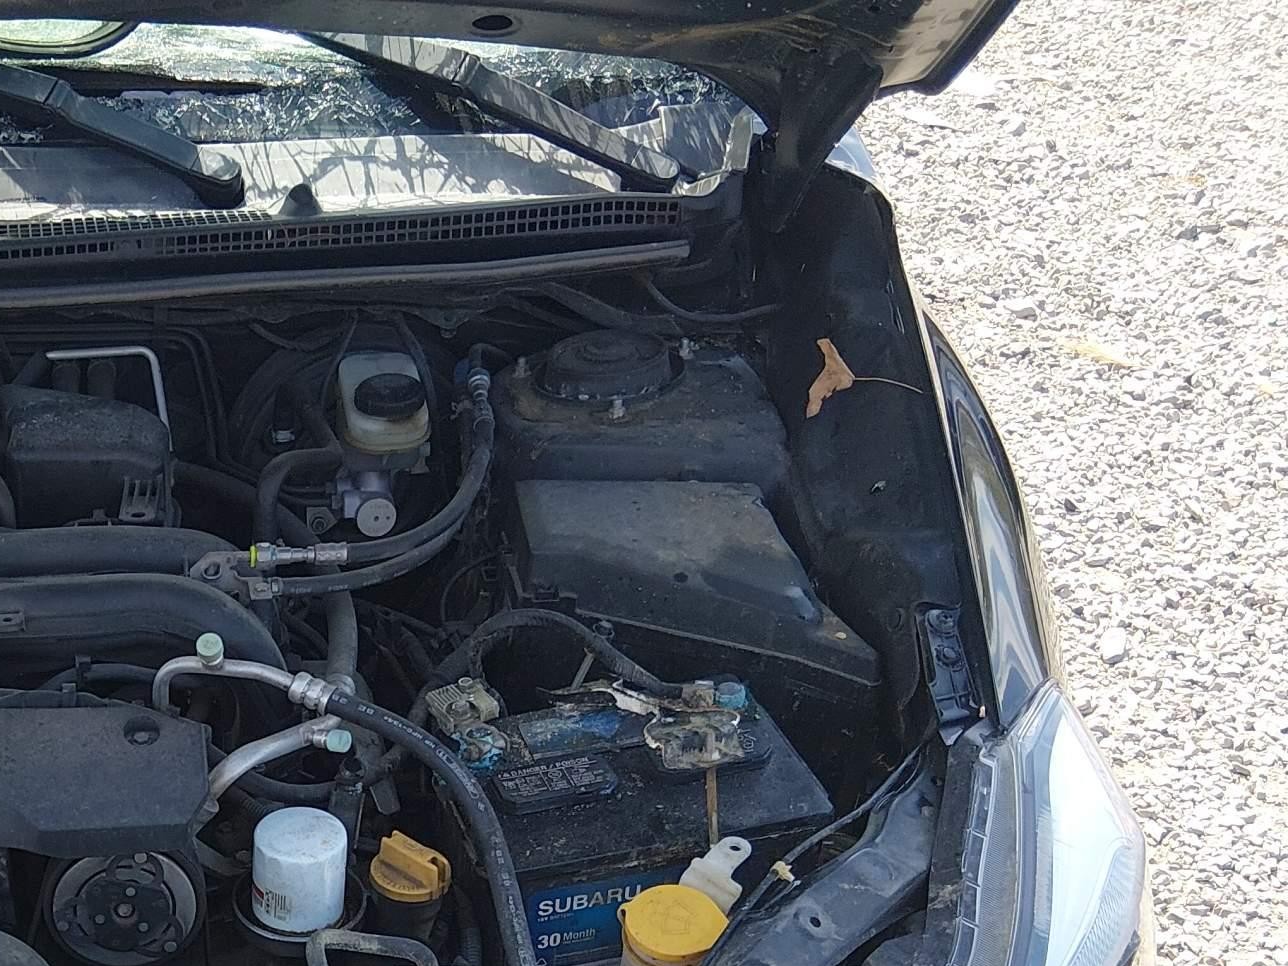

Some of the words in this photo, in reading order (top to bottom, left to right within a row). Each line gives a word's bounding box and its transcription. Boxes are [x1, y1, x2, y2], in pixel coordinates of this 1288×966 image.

[537, 884, 642, 917] SUBARU
[537, 932, 561, 949] 30
[562, 927, 596, 942] Month
